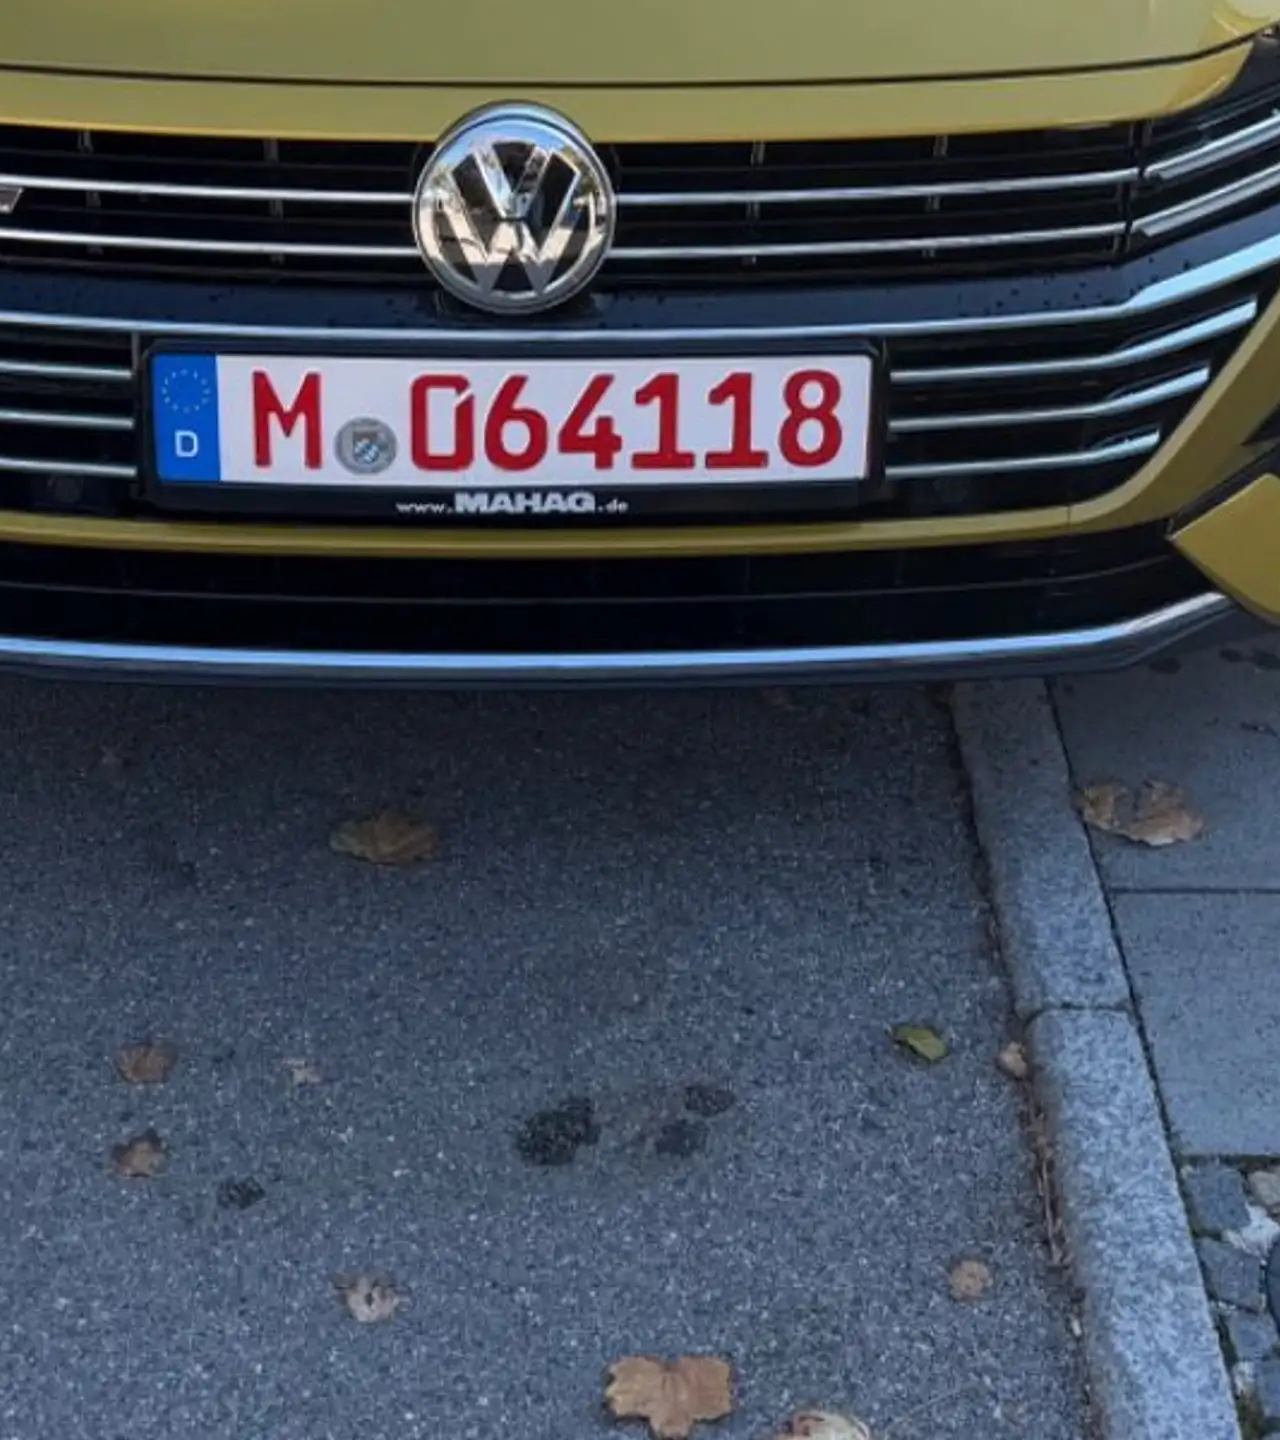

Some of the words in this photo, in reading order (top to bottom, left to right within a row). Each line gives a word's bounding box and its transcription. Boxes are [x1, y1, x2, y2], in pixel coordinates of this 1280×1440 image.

[252, 370, 322, 469] M
[174, 429, 199, 458] D
[395, 491, 629, 515] www.MAHAG.de
